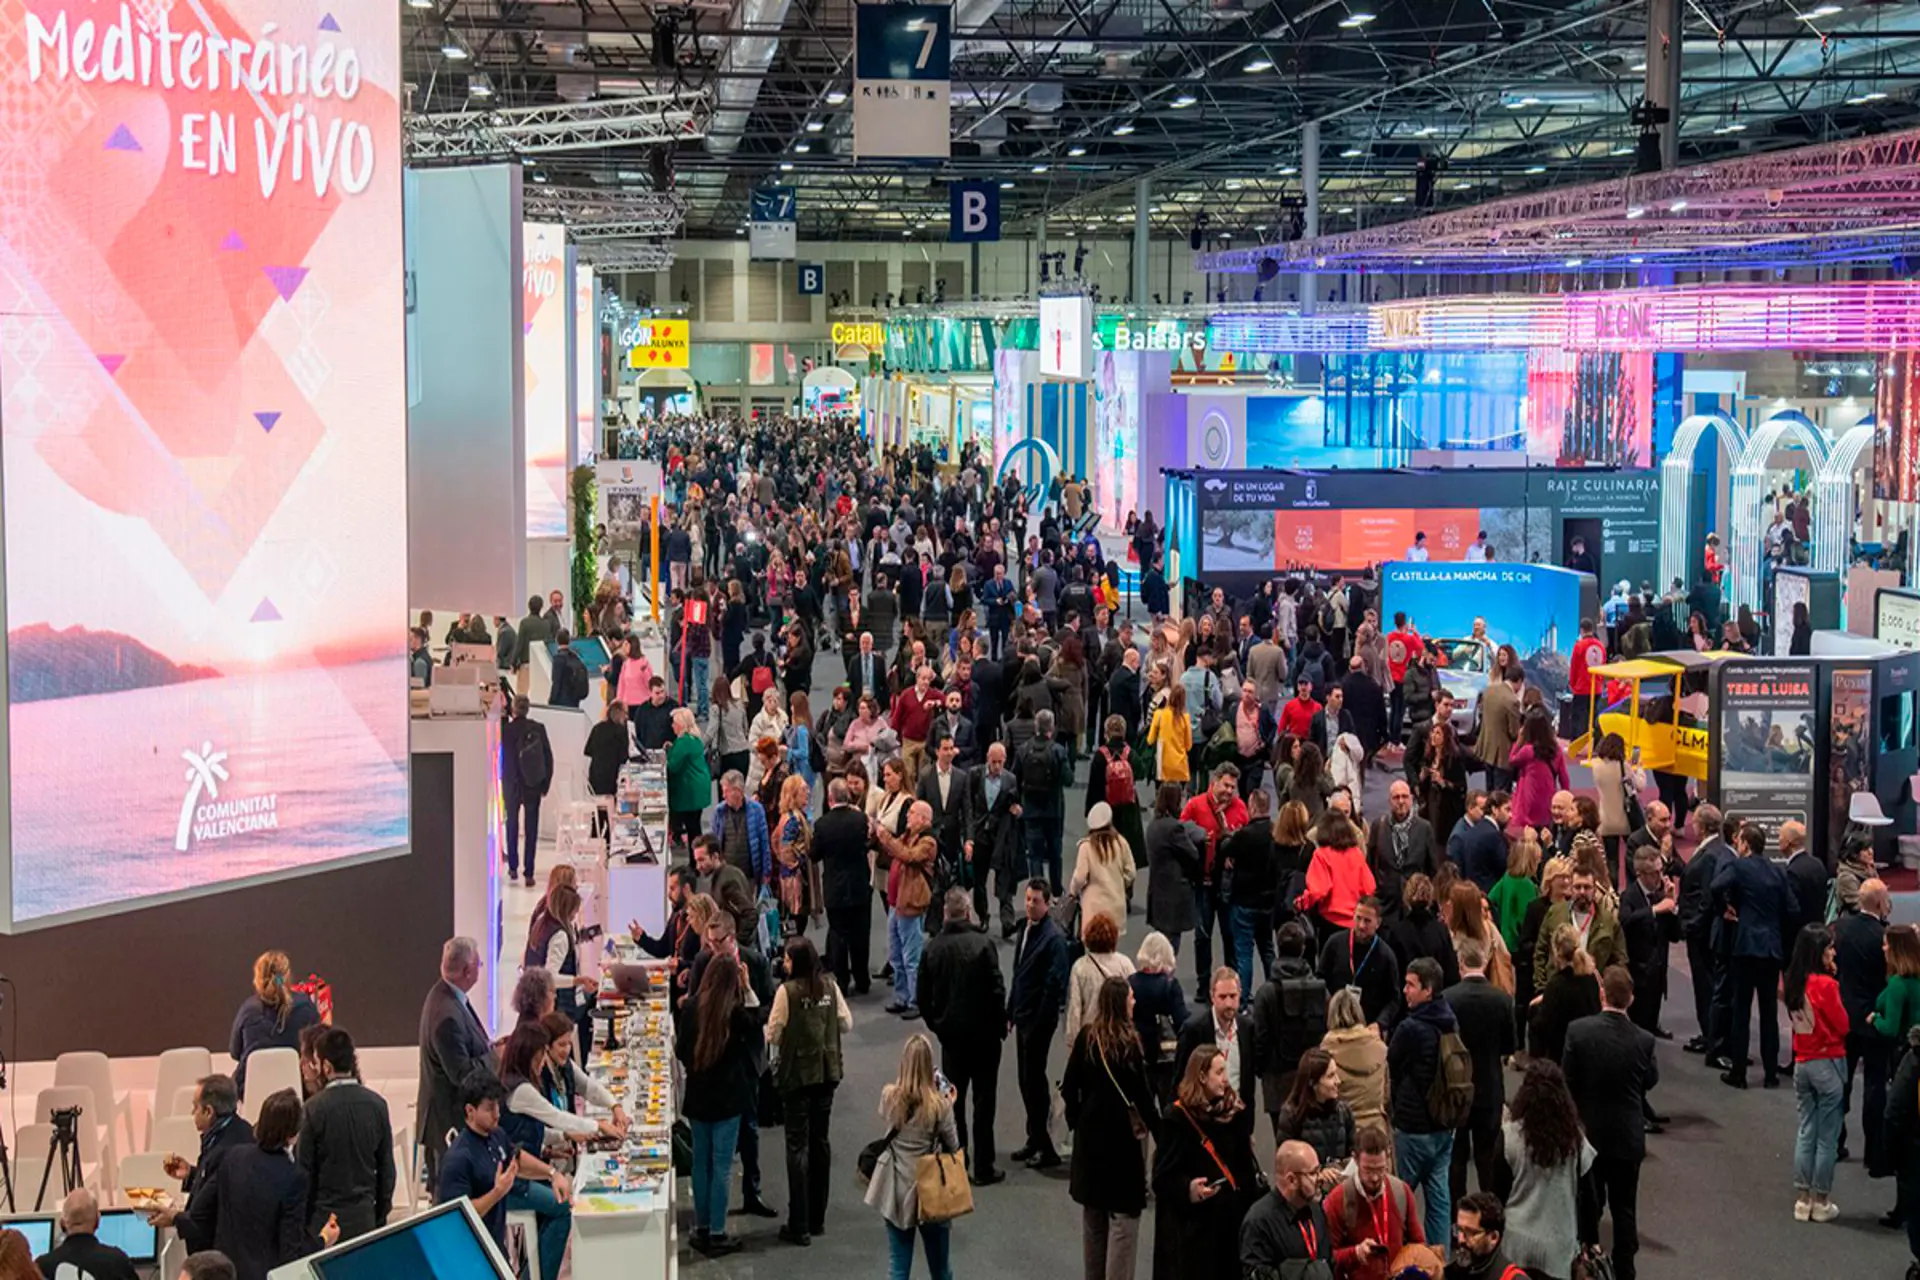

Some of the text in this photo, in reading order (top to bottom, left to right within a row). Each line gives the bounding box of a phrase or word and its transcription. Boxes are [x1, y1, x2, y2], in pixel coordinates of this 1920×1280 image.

[907, 22, 938, 69] 7
[179, 110, 237, 176] EN
[777, 194, 791, 217] 7
[963, 191, 988, 233] B
[804, 269, 817, 291] B
[831, 322, 888, 344] Catalu
[1114, 327, 1206, 350] Balears
[1233, 482, 1244, 491] EN
[1258, 482, 1285, 491] LUGAR
[1233, 493, 1276, 502] DE TU VIDA
[1583, 480, 1659, 496] CULINARIA
[1391, 571, 1452, 581] CASTILLA-LA
[1453, 571, 1498, 581] MANCHA
[1501, 572, 1513, 581] DE
[1727, 682, 1810, 695] TERE & LUISA
[1671, 728, 1709, 751] CLM
[196, 794, 276, 822] COMUNITAT
[193, 812, 279, 842] VALENCIANA
